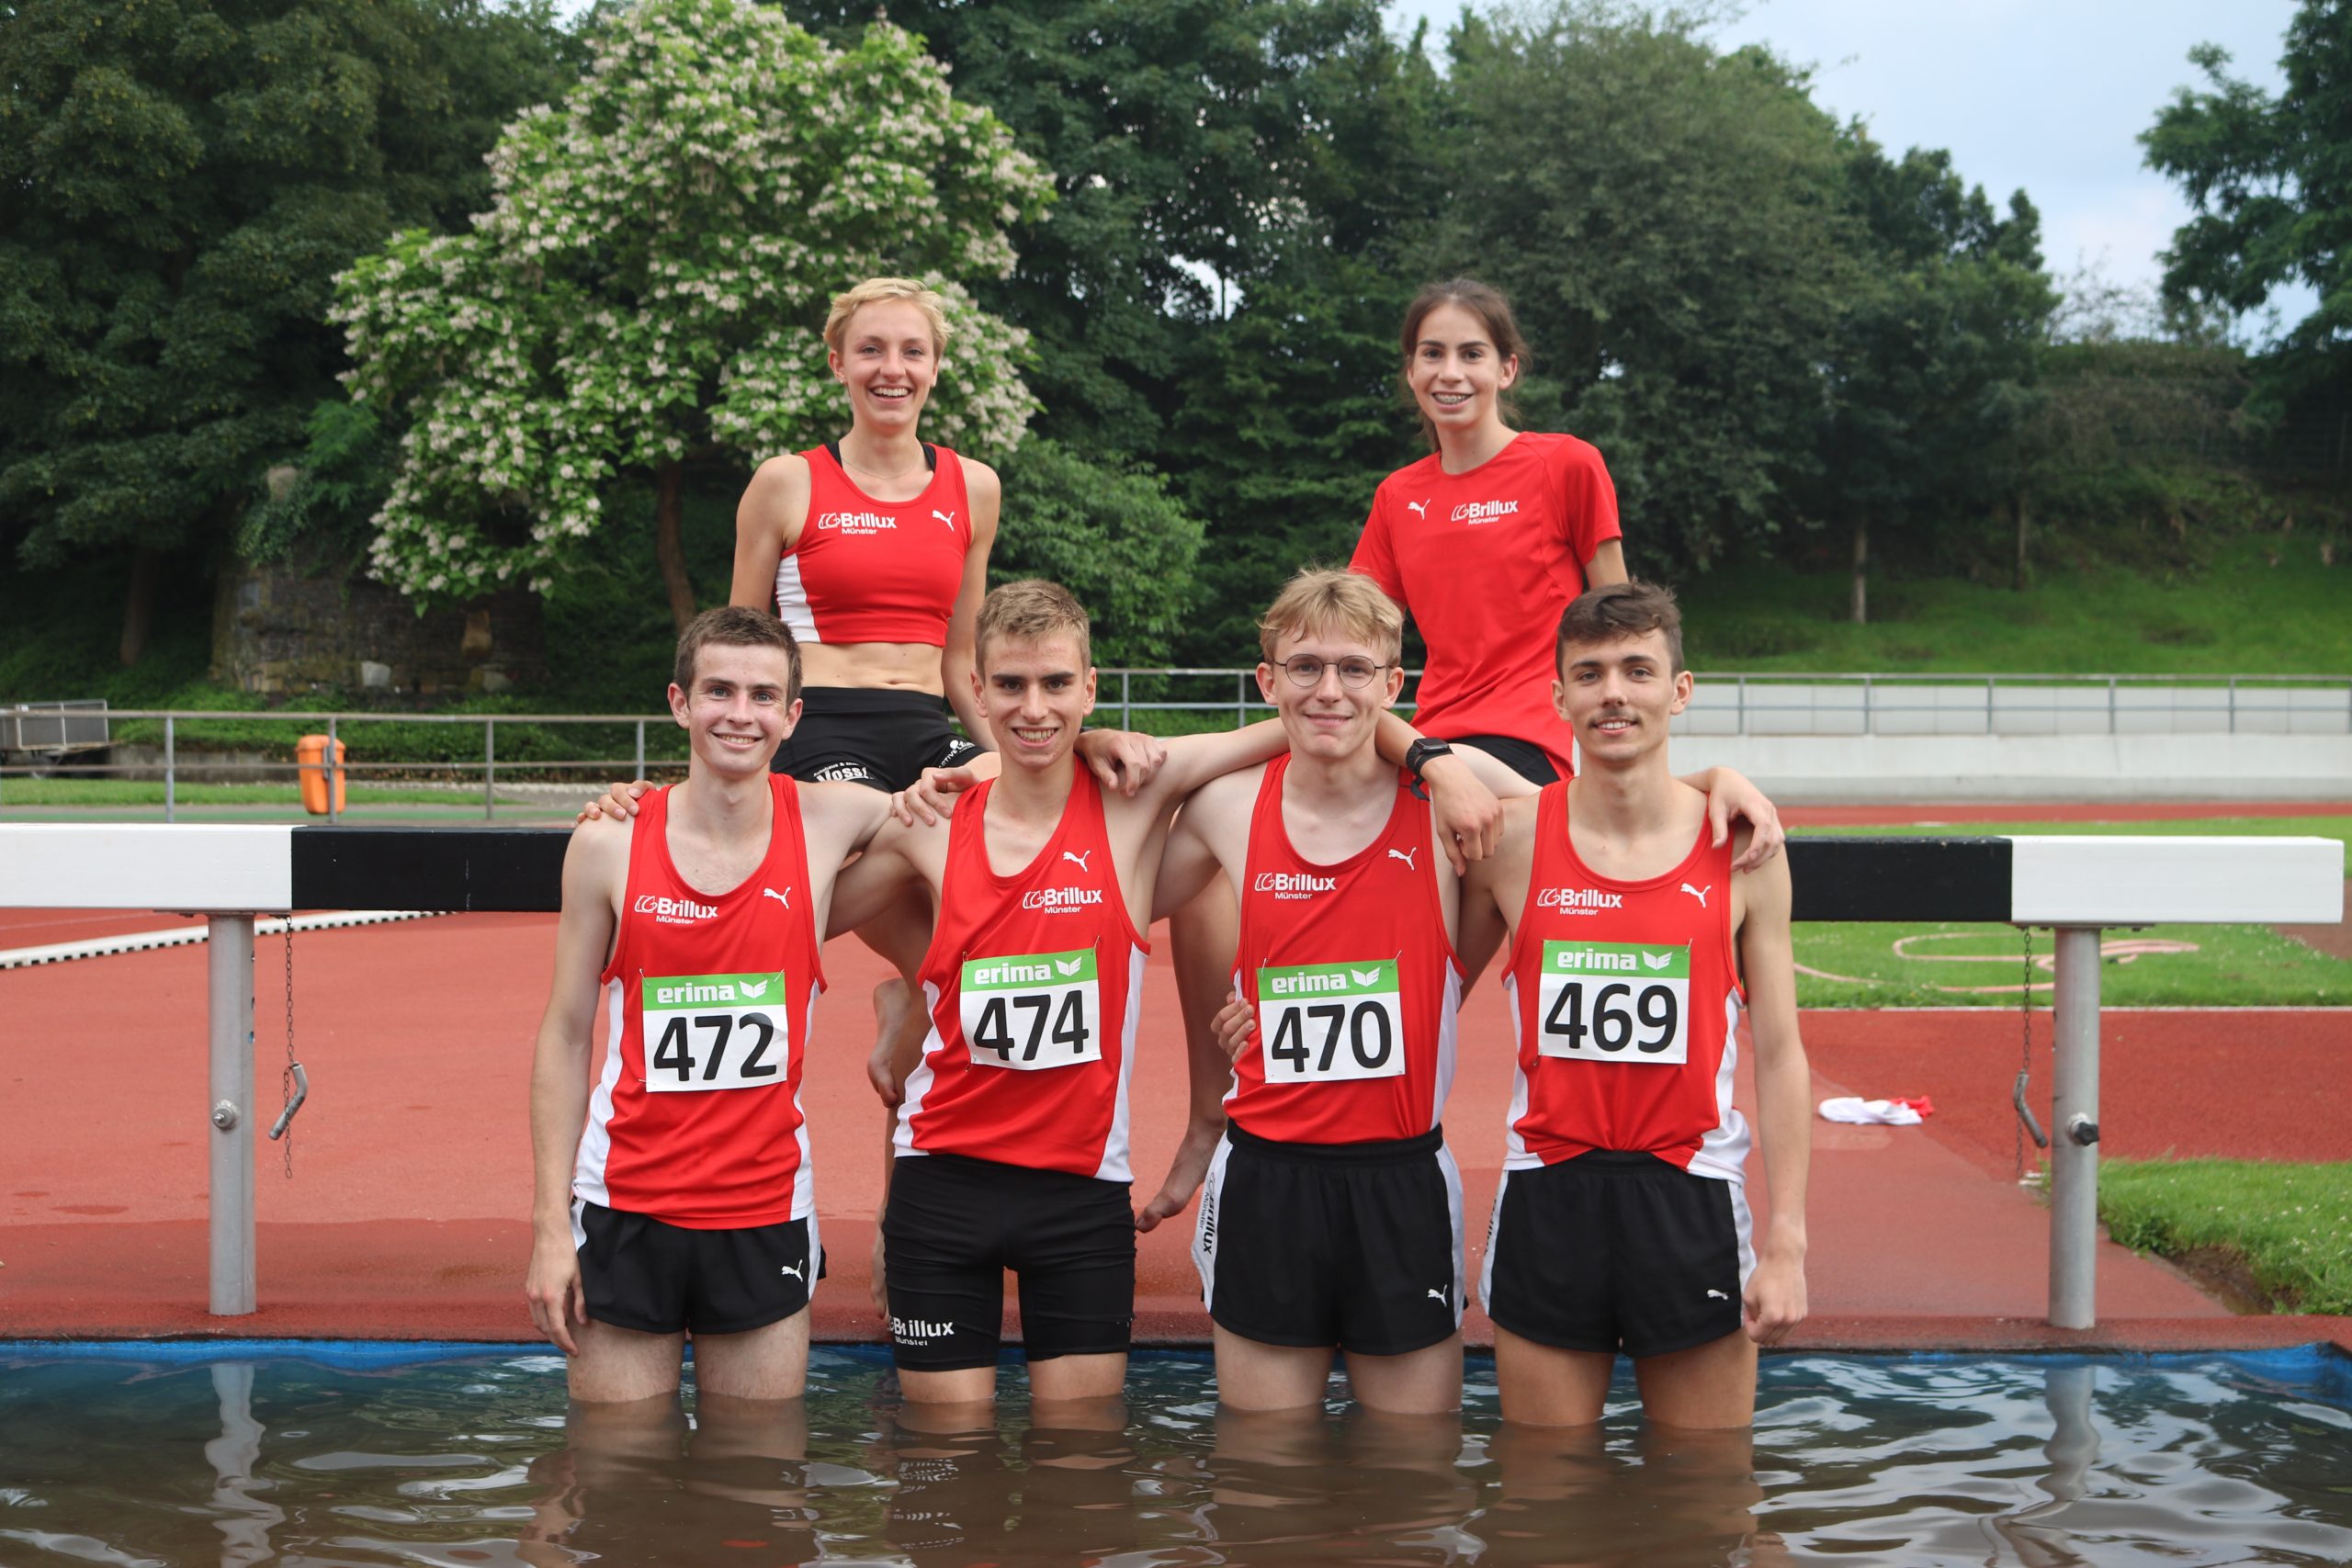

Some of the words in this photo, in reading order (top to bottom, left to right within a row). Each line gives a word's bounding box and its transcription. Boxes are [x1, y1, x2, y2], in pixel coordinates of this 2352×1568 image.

[1469, 500, 1519, 518] Brillux
[841, 513, 897, 529] Brillux
[1468, 516, 1499, 525] Münster
[938, 750, 958, 768] CTIVE
[1275, 873, 1337, 891] Brillux
[1045, 886, 1102, 907] Brillux
[1274, 891, 1313, 900] Münster
[1560, 888, 1623, 908] Brillux
[657, 897, 718, 919] Brillux
[1044, 906, 1081, 915] Münster
[1559, 907, 1599, 916] Münster
[656, 915, 695, 925] Münster
[1556, 947, 1637, 971] erima
[974, 962, 1052, 985] erima
[1272, 972, 1348, 994] erima
[657, 982, 736, 1004] erima
[973, 989, 1090, 1061] 474
[1544, 982, 1678, 1054] 469
[1272, 1000, 1392, 1073] 470
[653, 1012, 777, 1082] 472
